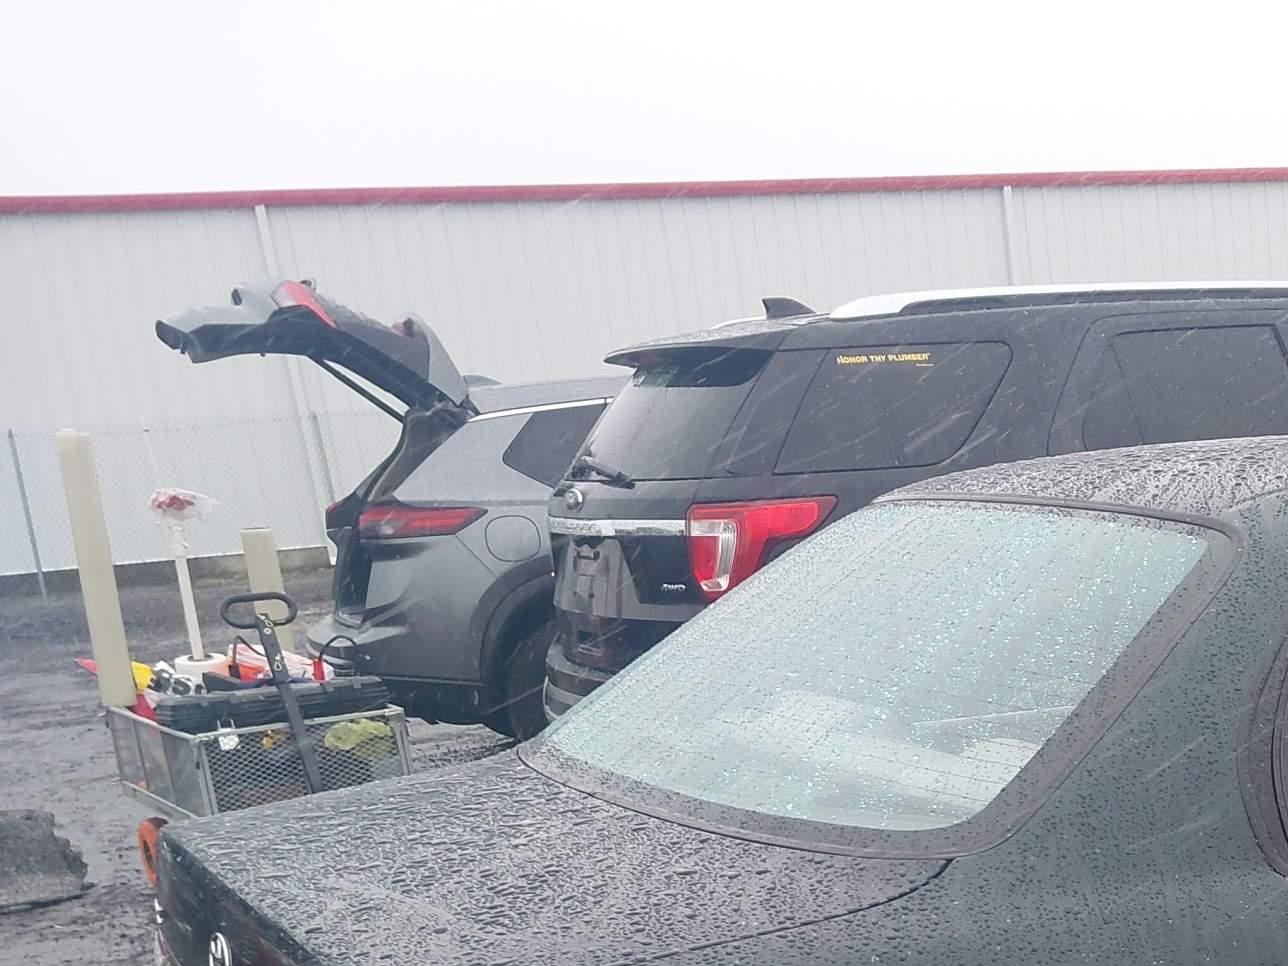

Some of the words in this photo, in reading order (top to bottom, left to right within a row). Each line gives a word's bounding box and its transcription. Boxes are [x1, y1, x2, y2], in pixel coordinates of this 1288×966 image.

[836, 355, 868, 364] HONOR
[869, 354, 887, 363] THY
[887, 353, 929, 362] PLUMBER
